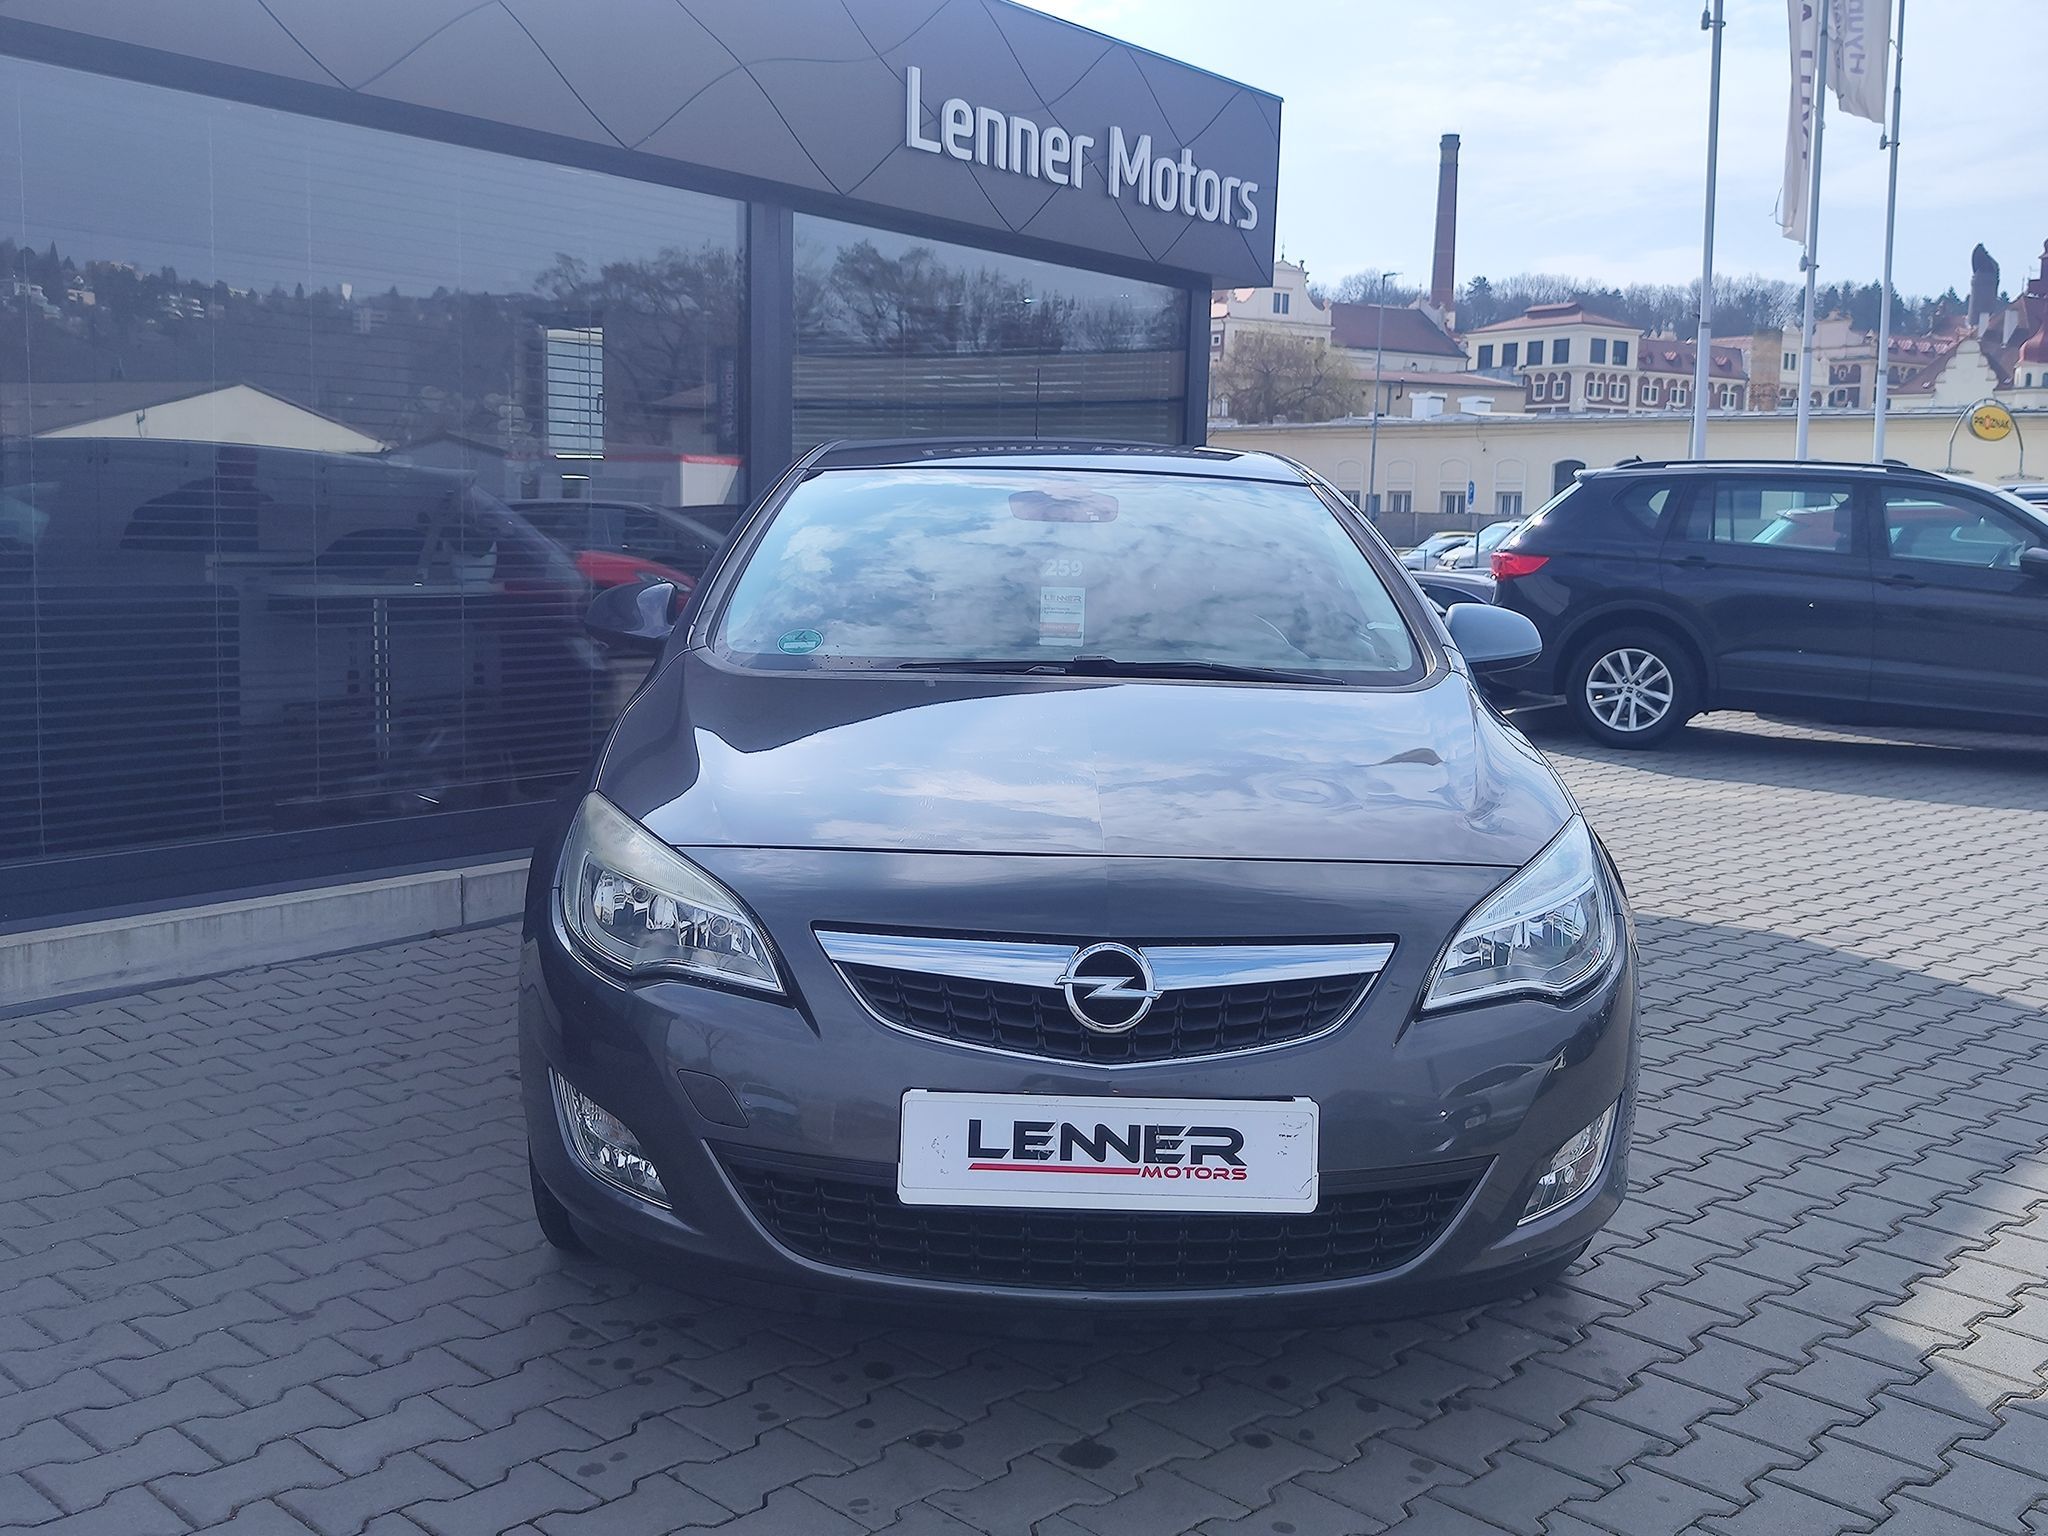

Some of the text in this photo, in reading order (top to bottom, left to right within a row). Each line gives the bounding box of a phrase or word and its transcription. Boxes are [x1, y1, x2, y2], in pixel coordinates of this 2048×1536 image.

[906, 66, 1259, 231] Lenner Motors
[1044, 559, 1083, 577] 259
[967, 1118, 1248, 1167] LENNER
[1141, 1166, 1248, 1181] MOTORS
